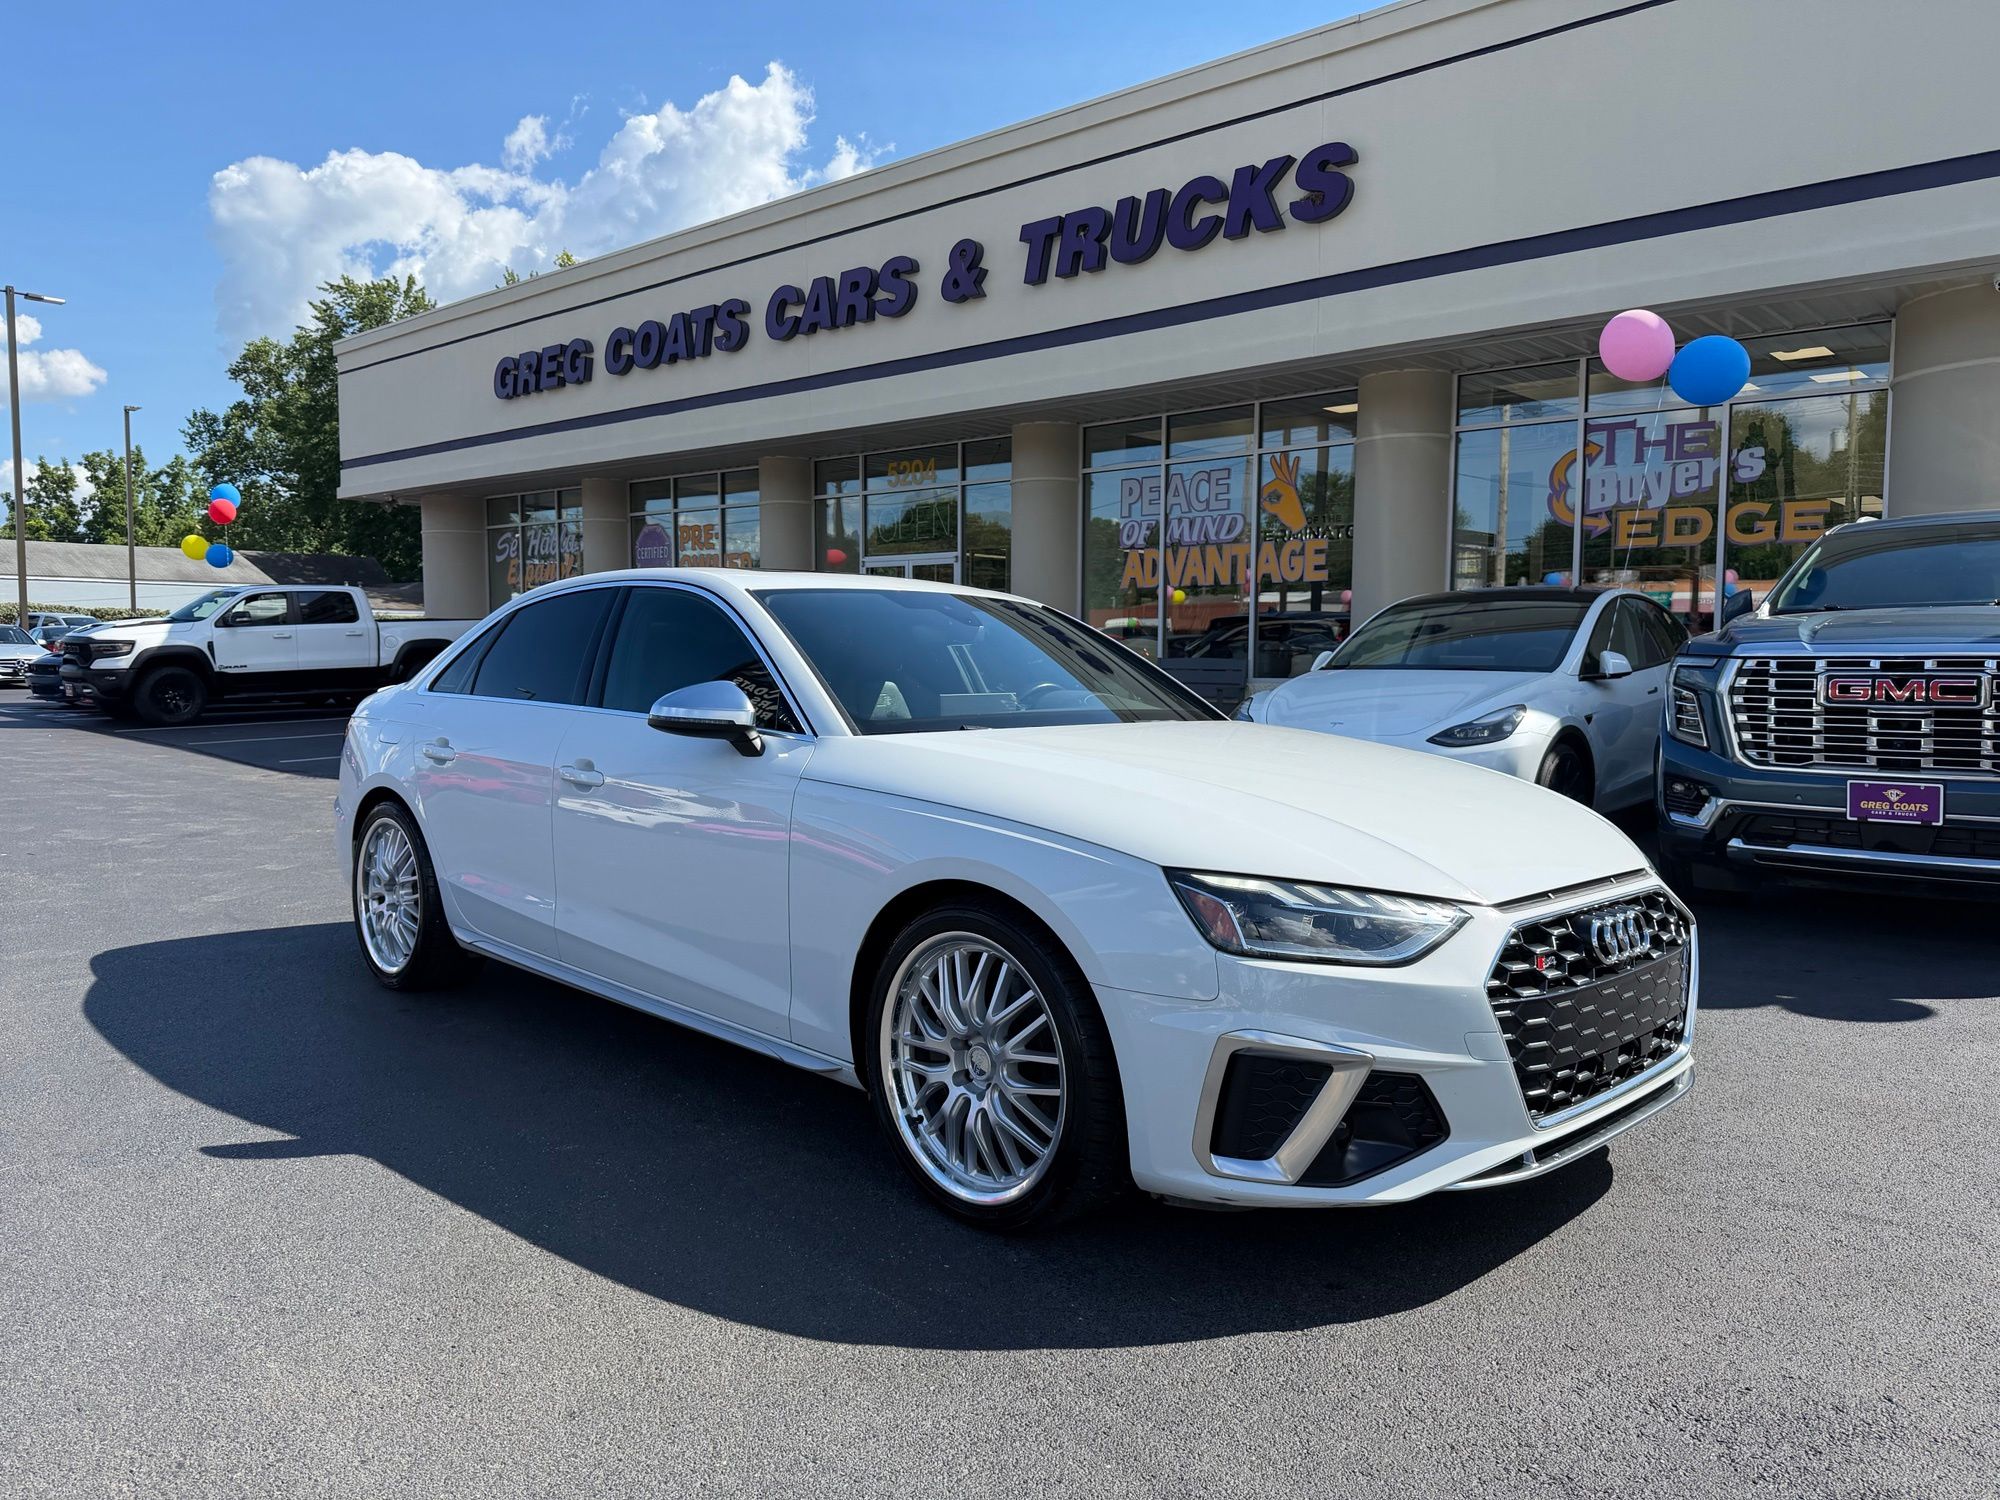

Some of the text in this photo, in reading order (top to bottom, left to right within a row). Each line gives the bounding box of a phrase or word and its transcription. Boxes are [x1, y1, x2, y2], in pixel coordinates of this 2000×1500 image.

[494, 142, 1359, 401] GREG COATS CARS & TRUCKS
[1586, 418, 1716, 466] THE
[887, 457, 937, 488] 5204
[1120, 467, 1231, 518] PEACE
[1584, 445, 1767, 514] Buyer's
[679, 523, 720, 552] PRE-
[877, 502, 950, 542] OPEN
[1120, 512, 1246, 549] OF MIND
[1615, 500, 1830, 549] EDGE
[637, 545, 669, 560] CERTIFIED
[1120, 538, 1329, 589] ADVANTAGE
[1828, 678, 1978, 703] GMC
[1860, 801, 1928, 811] GREG COATS
